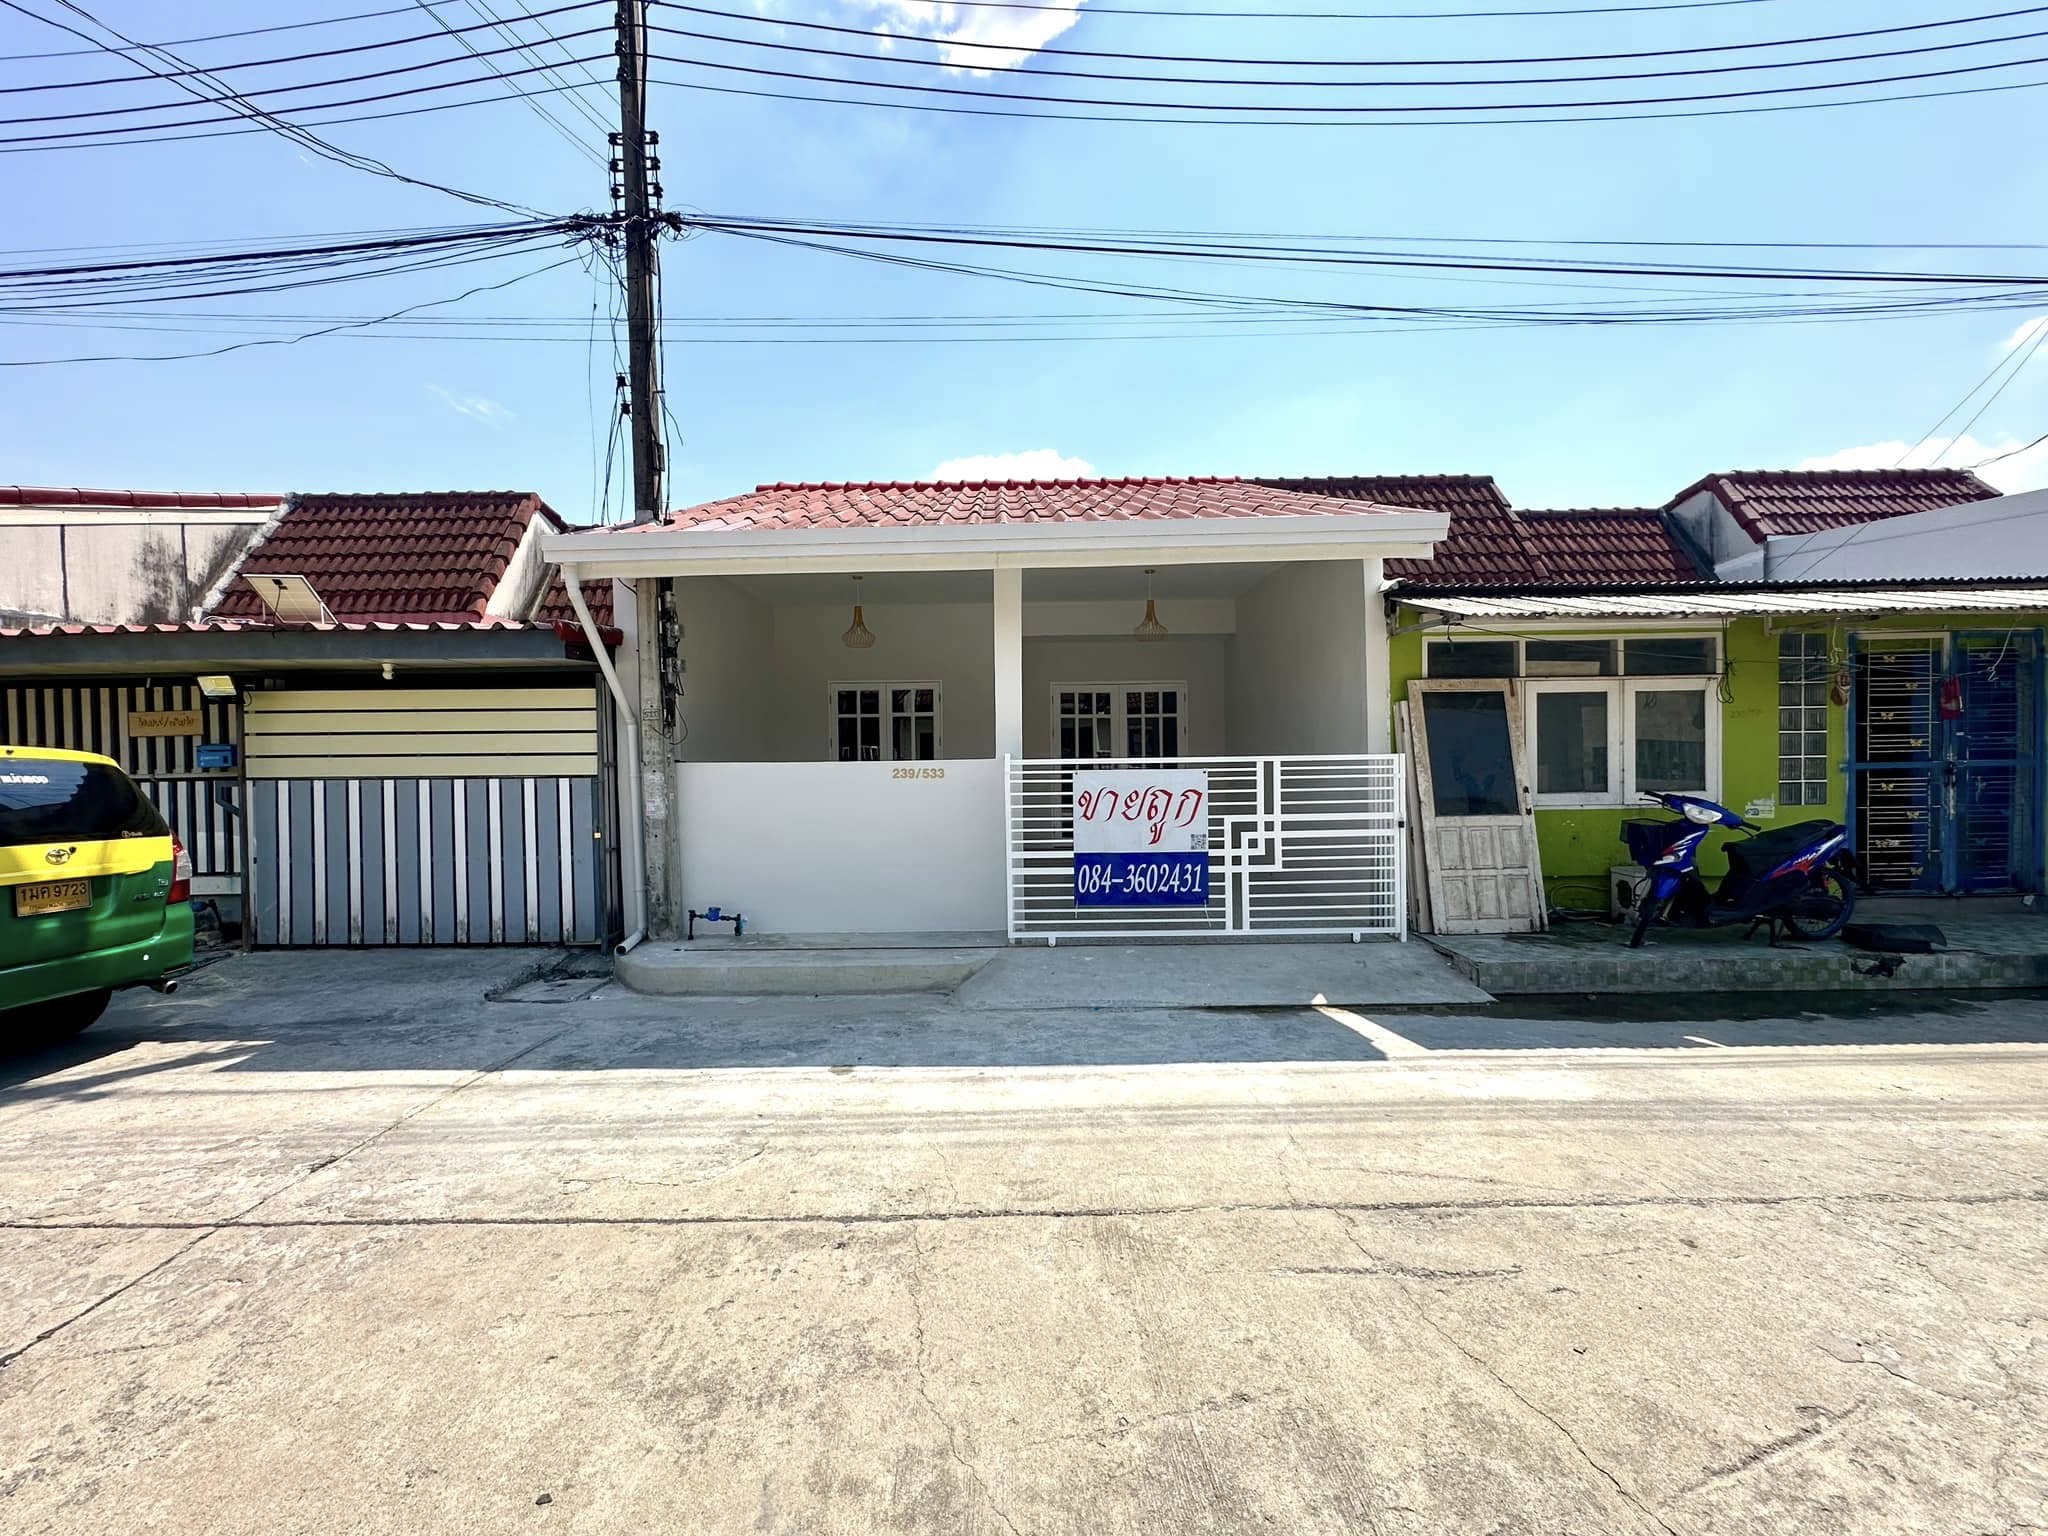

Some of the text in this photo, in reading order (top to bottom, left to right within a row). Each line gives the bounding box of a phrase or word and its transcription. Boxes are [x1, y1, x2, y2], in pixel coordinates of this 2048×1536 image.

[892, 768, 945, 779] 239/533
[1077, 785, 1204, 845] ขายถูก
[54, 882, 88, 898] 9723
[1078, 863, 1203, 894] 084-3602431
